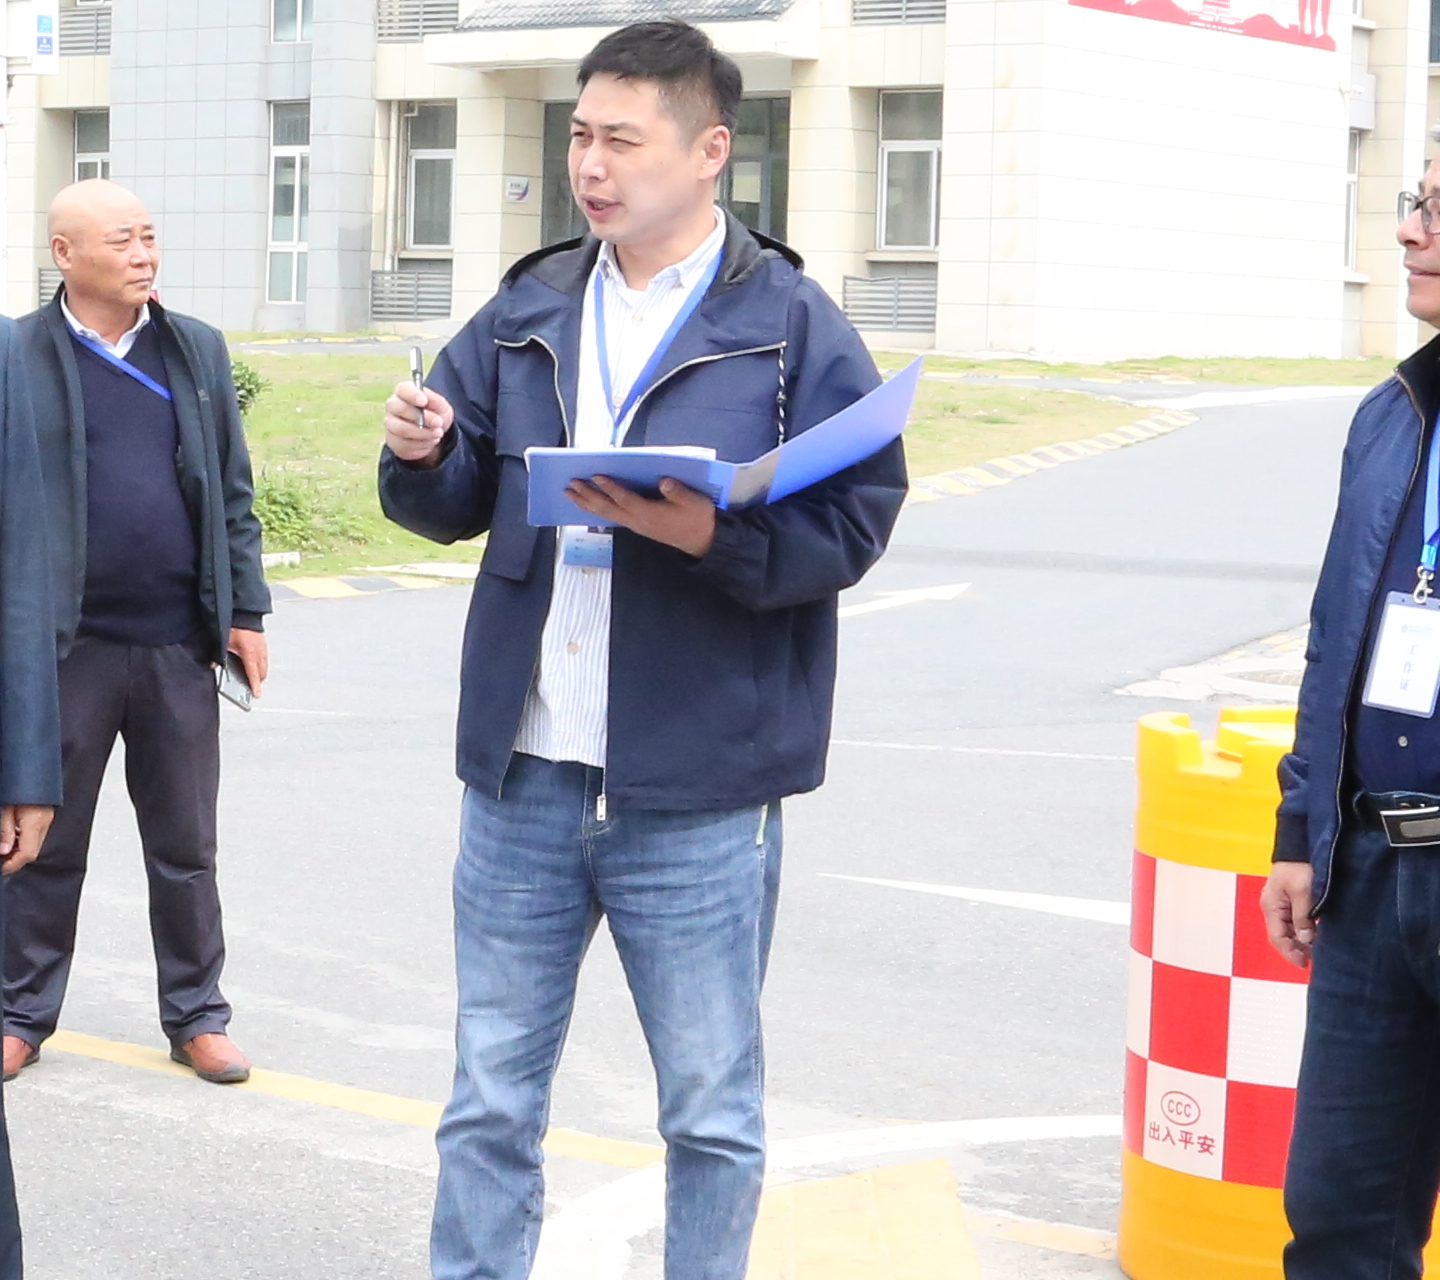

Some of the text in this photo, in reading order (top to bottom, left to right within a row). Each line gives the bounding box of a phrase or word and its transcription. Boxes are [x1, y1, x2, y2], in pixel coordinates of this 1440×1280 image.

[1399, 643, 1419, 691] 工作证
[1167, 1098, 1193, 1118] CCC
[1147, 1120, 1216, 1156] 出入平安
